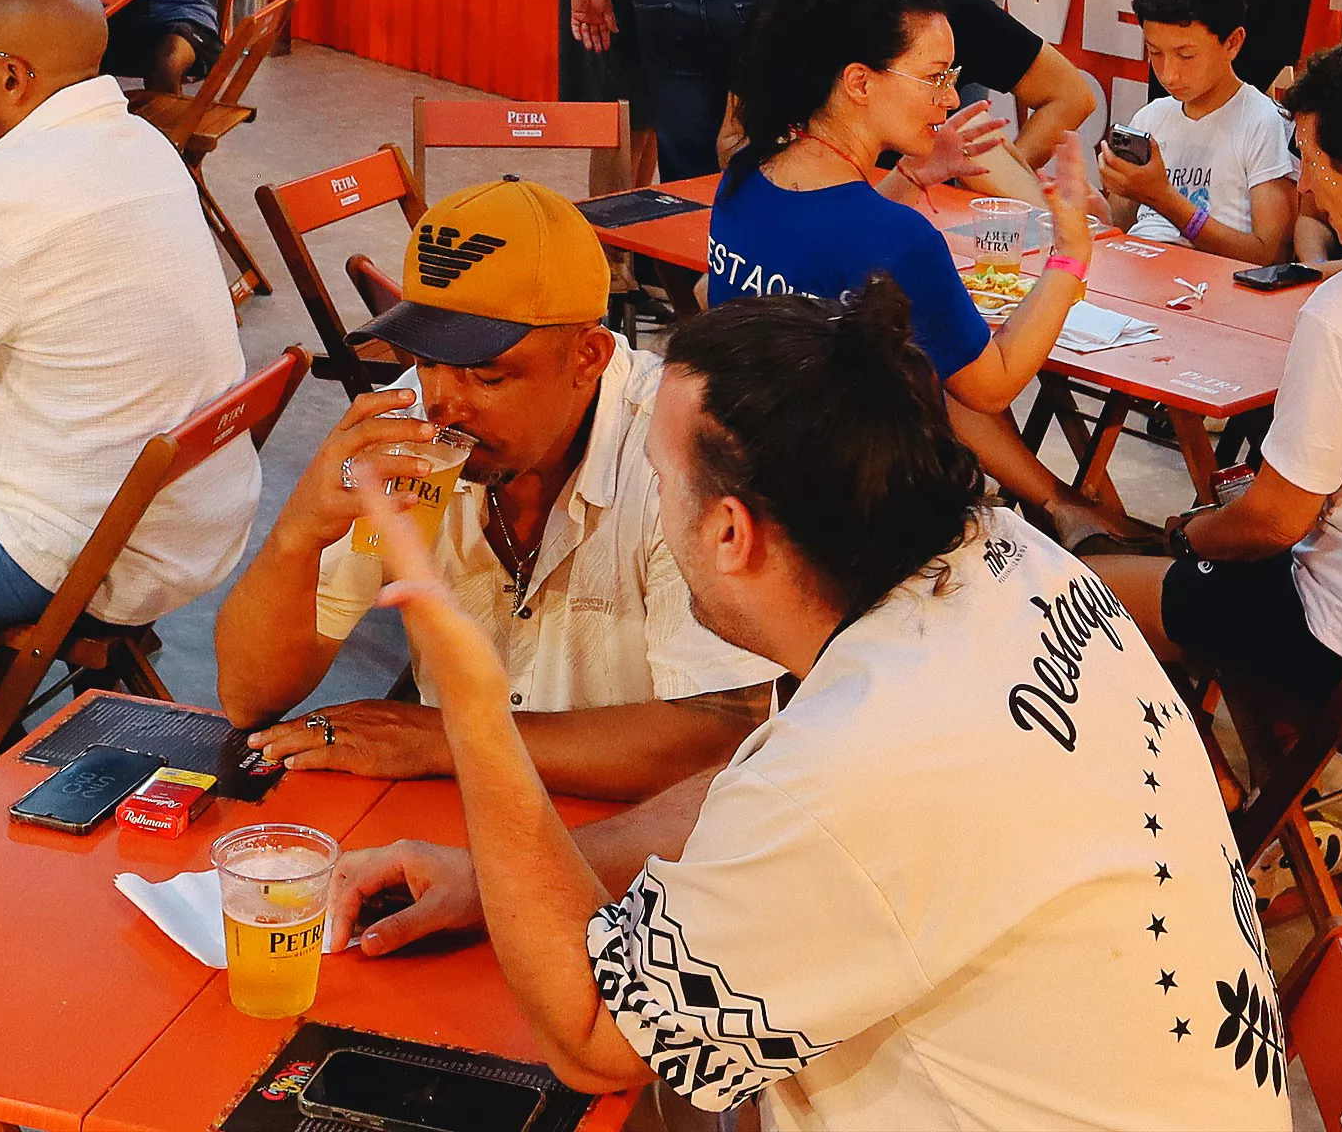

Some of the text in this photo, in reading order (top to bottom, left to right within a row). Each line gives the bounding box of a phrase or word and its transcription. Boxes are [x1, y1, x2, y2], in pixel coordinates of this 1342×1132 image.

[507, 110, 547, 124] PETRA
[330, 174, 359, 194] PETRA
[975, 236, 1009, 252] PETRA
[393, 476, 442, 504] ETRA
[1008, 574, 1130, 753] Destaqu
[120, 809, 172, 829] Rothmans
